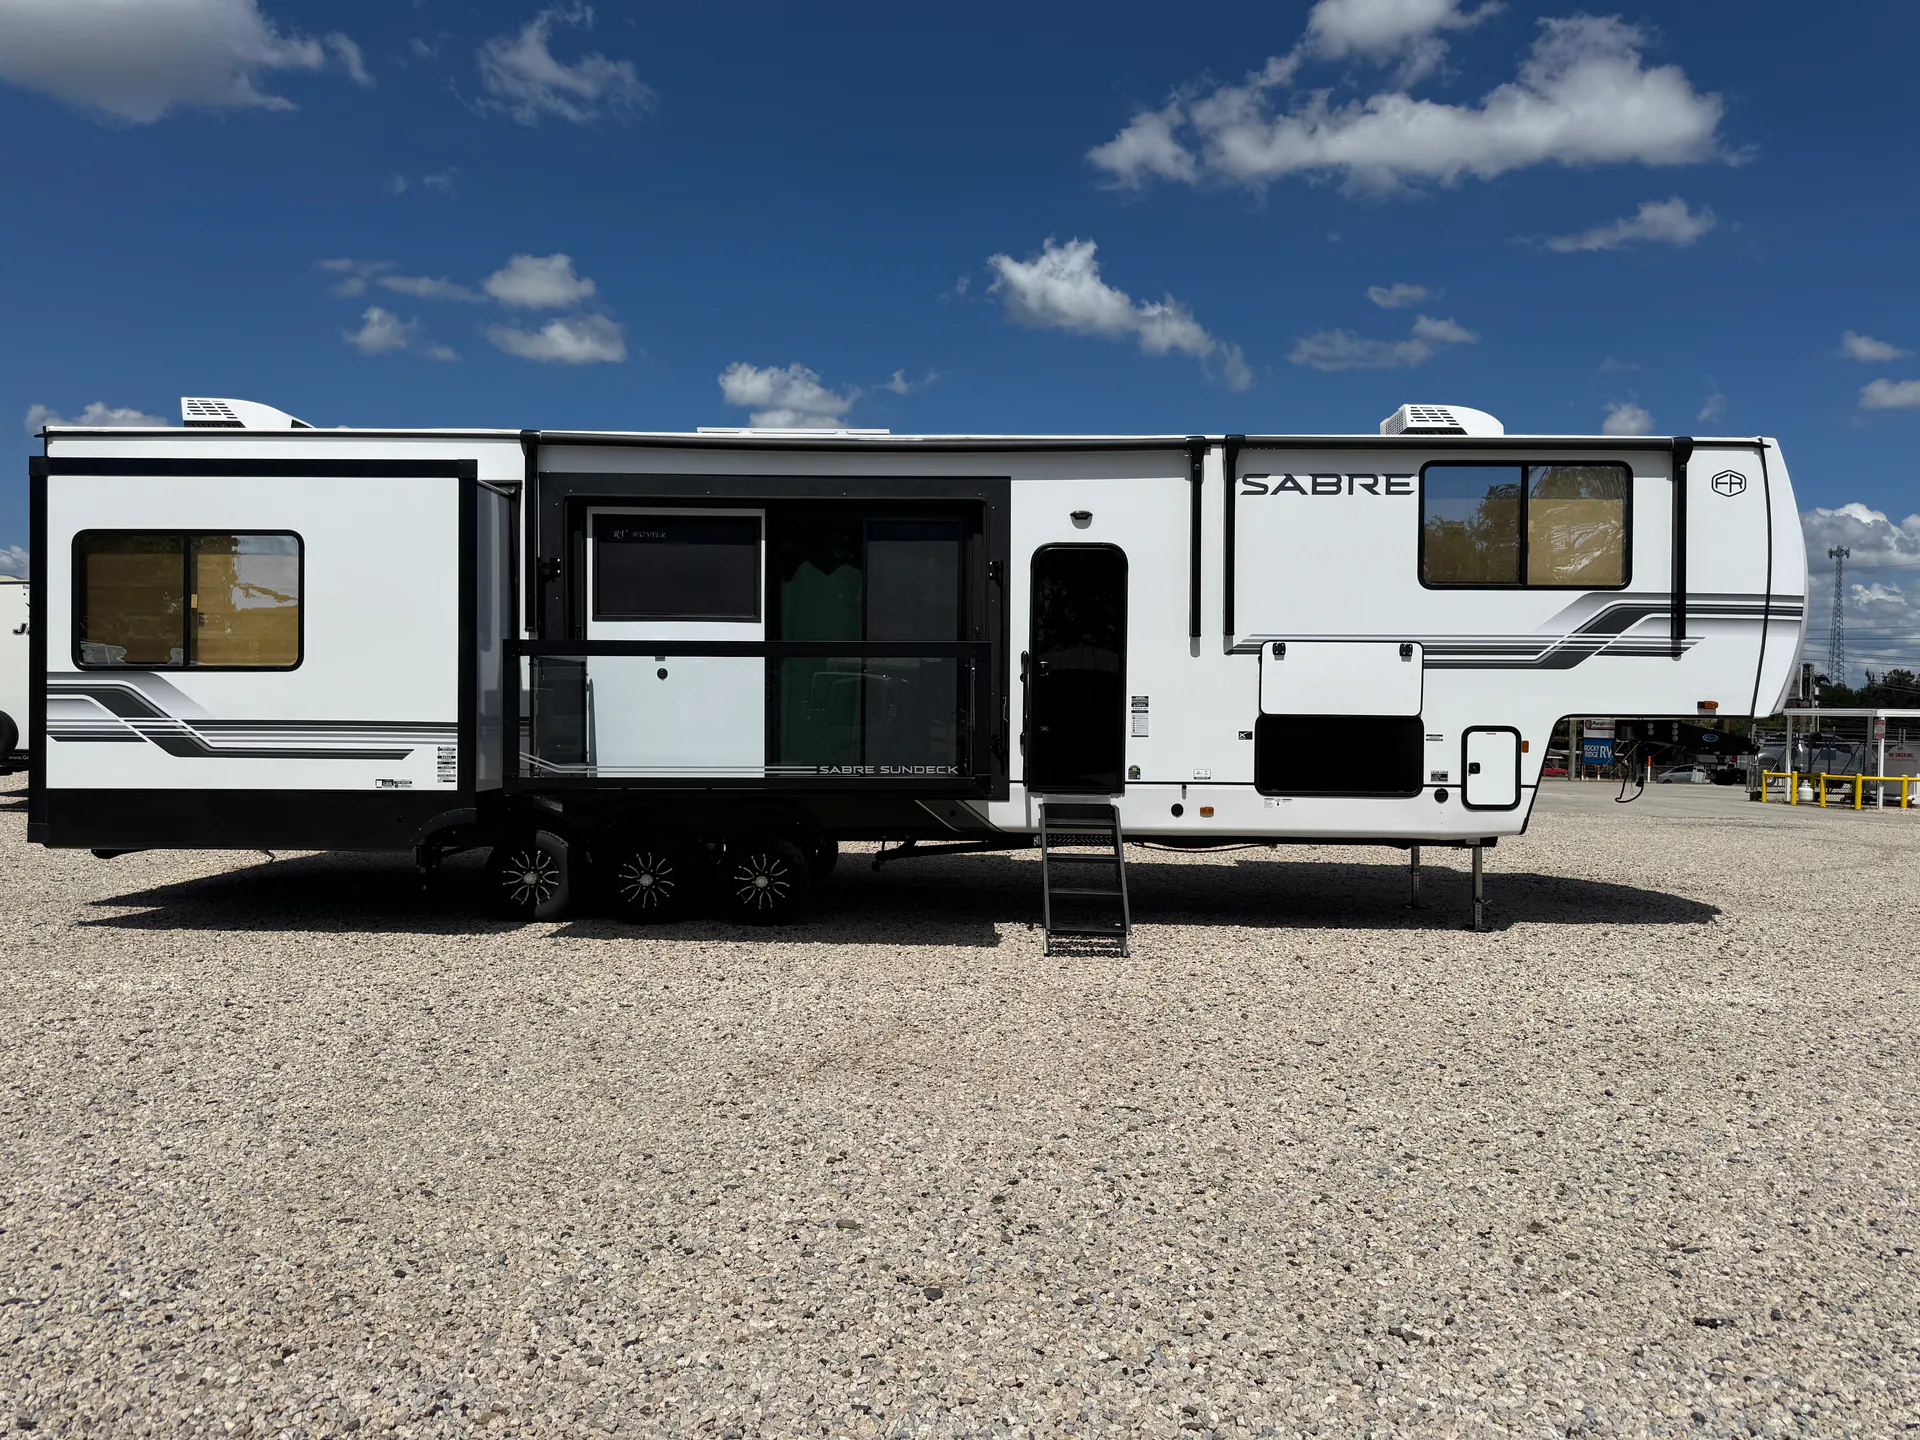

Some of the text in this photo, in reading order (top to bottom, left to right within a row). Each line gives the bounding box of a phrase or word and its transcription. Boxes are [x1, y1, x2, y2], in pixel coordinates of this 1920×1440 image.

[1240, 474, 1416, 495] SABRE
[1600, 745, 1612, 758] RV
[819, 765, 959, 774] SABRE SUNDECK
